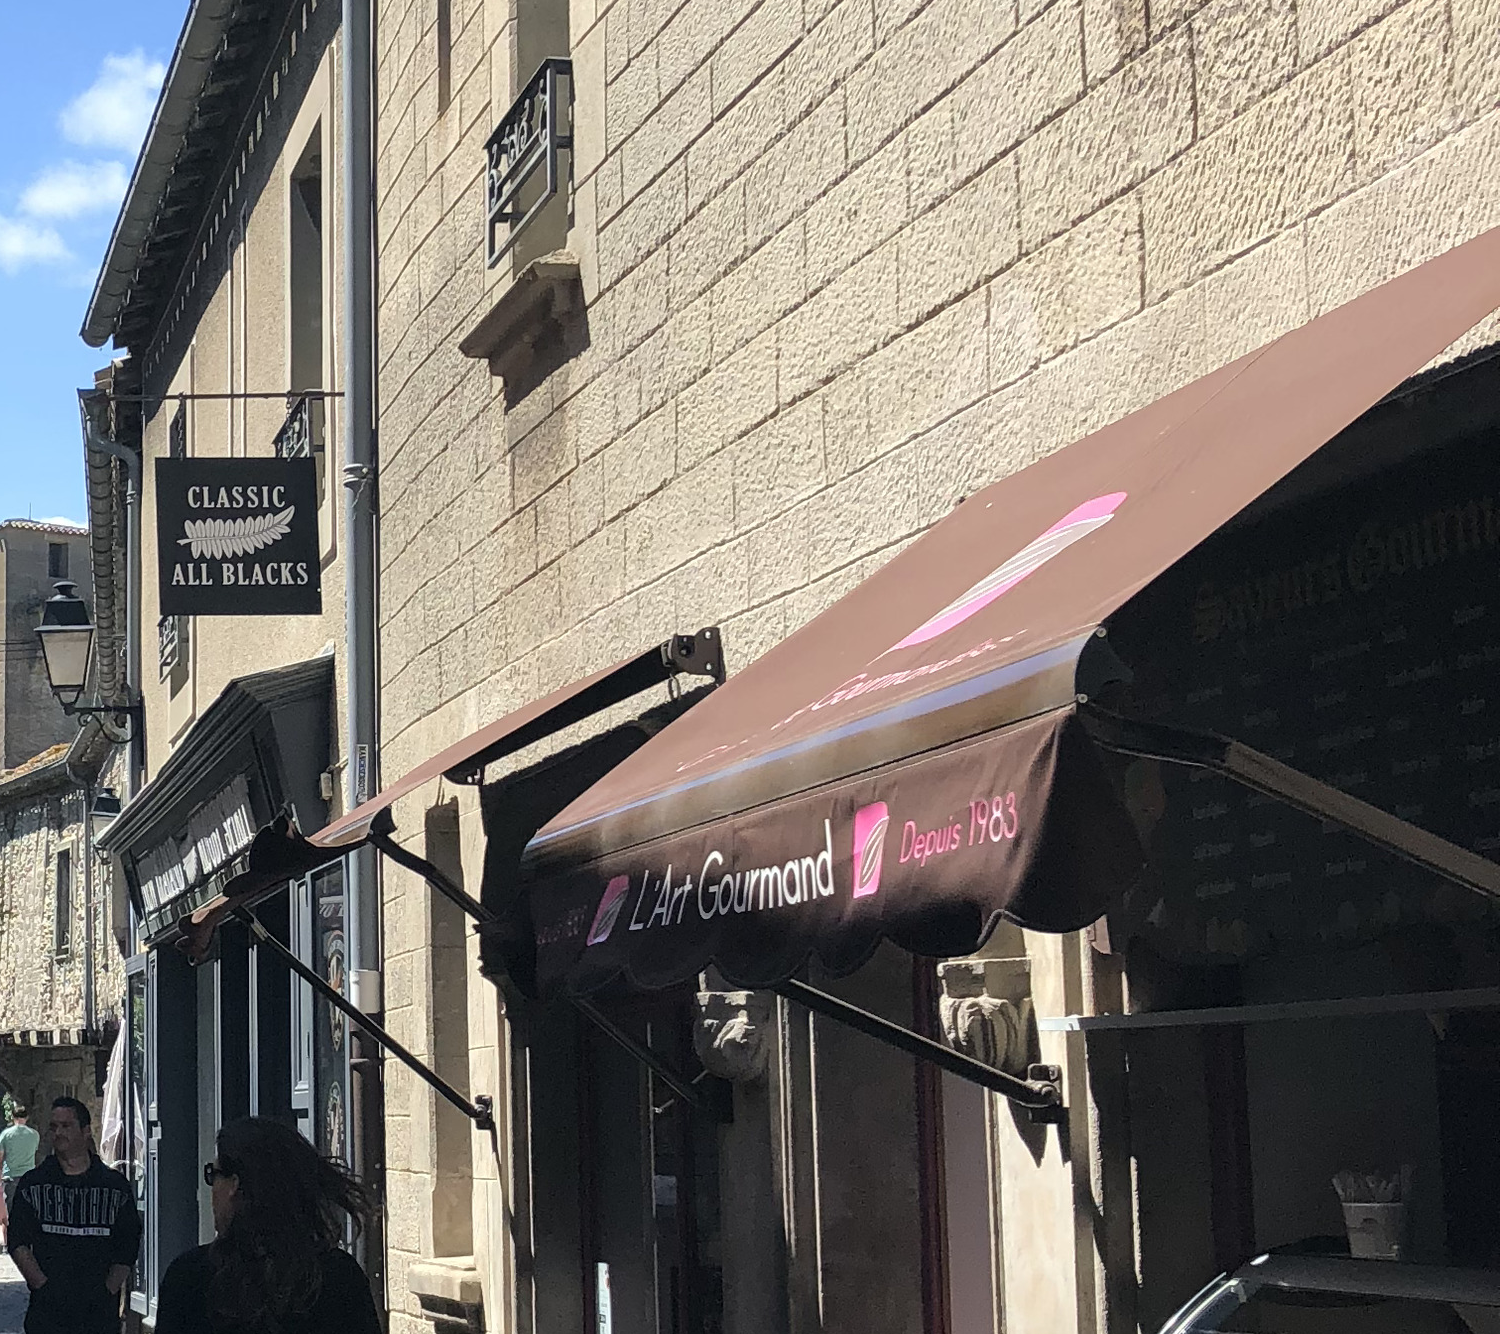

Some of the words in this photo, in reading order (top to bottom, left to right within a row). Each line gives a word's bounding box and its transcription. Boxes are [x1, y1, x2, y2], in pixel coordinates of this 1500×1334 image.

[187, 485, 286, 509] CLASSIC
[171, 563, 213, 586] ALL
[222, 562, 309, 586] BLACKS
[899, 820, 962, 868] Depuis
[967, 791, 1020, 848] 1983
[628, 864, 693, 932] L'Art
[697, 818, 835, 921] Gourmand
